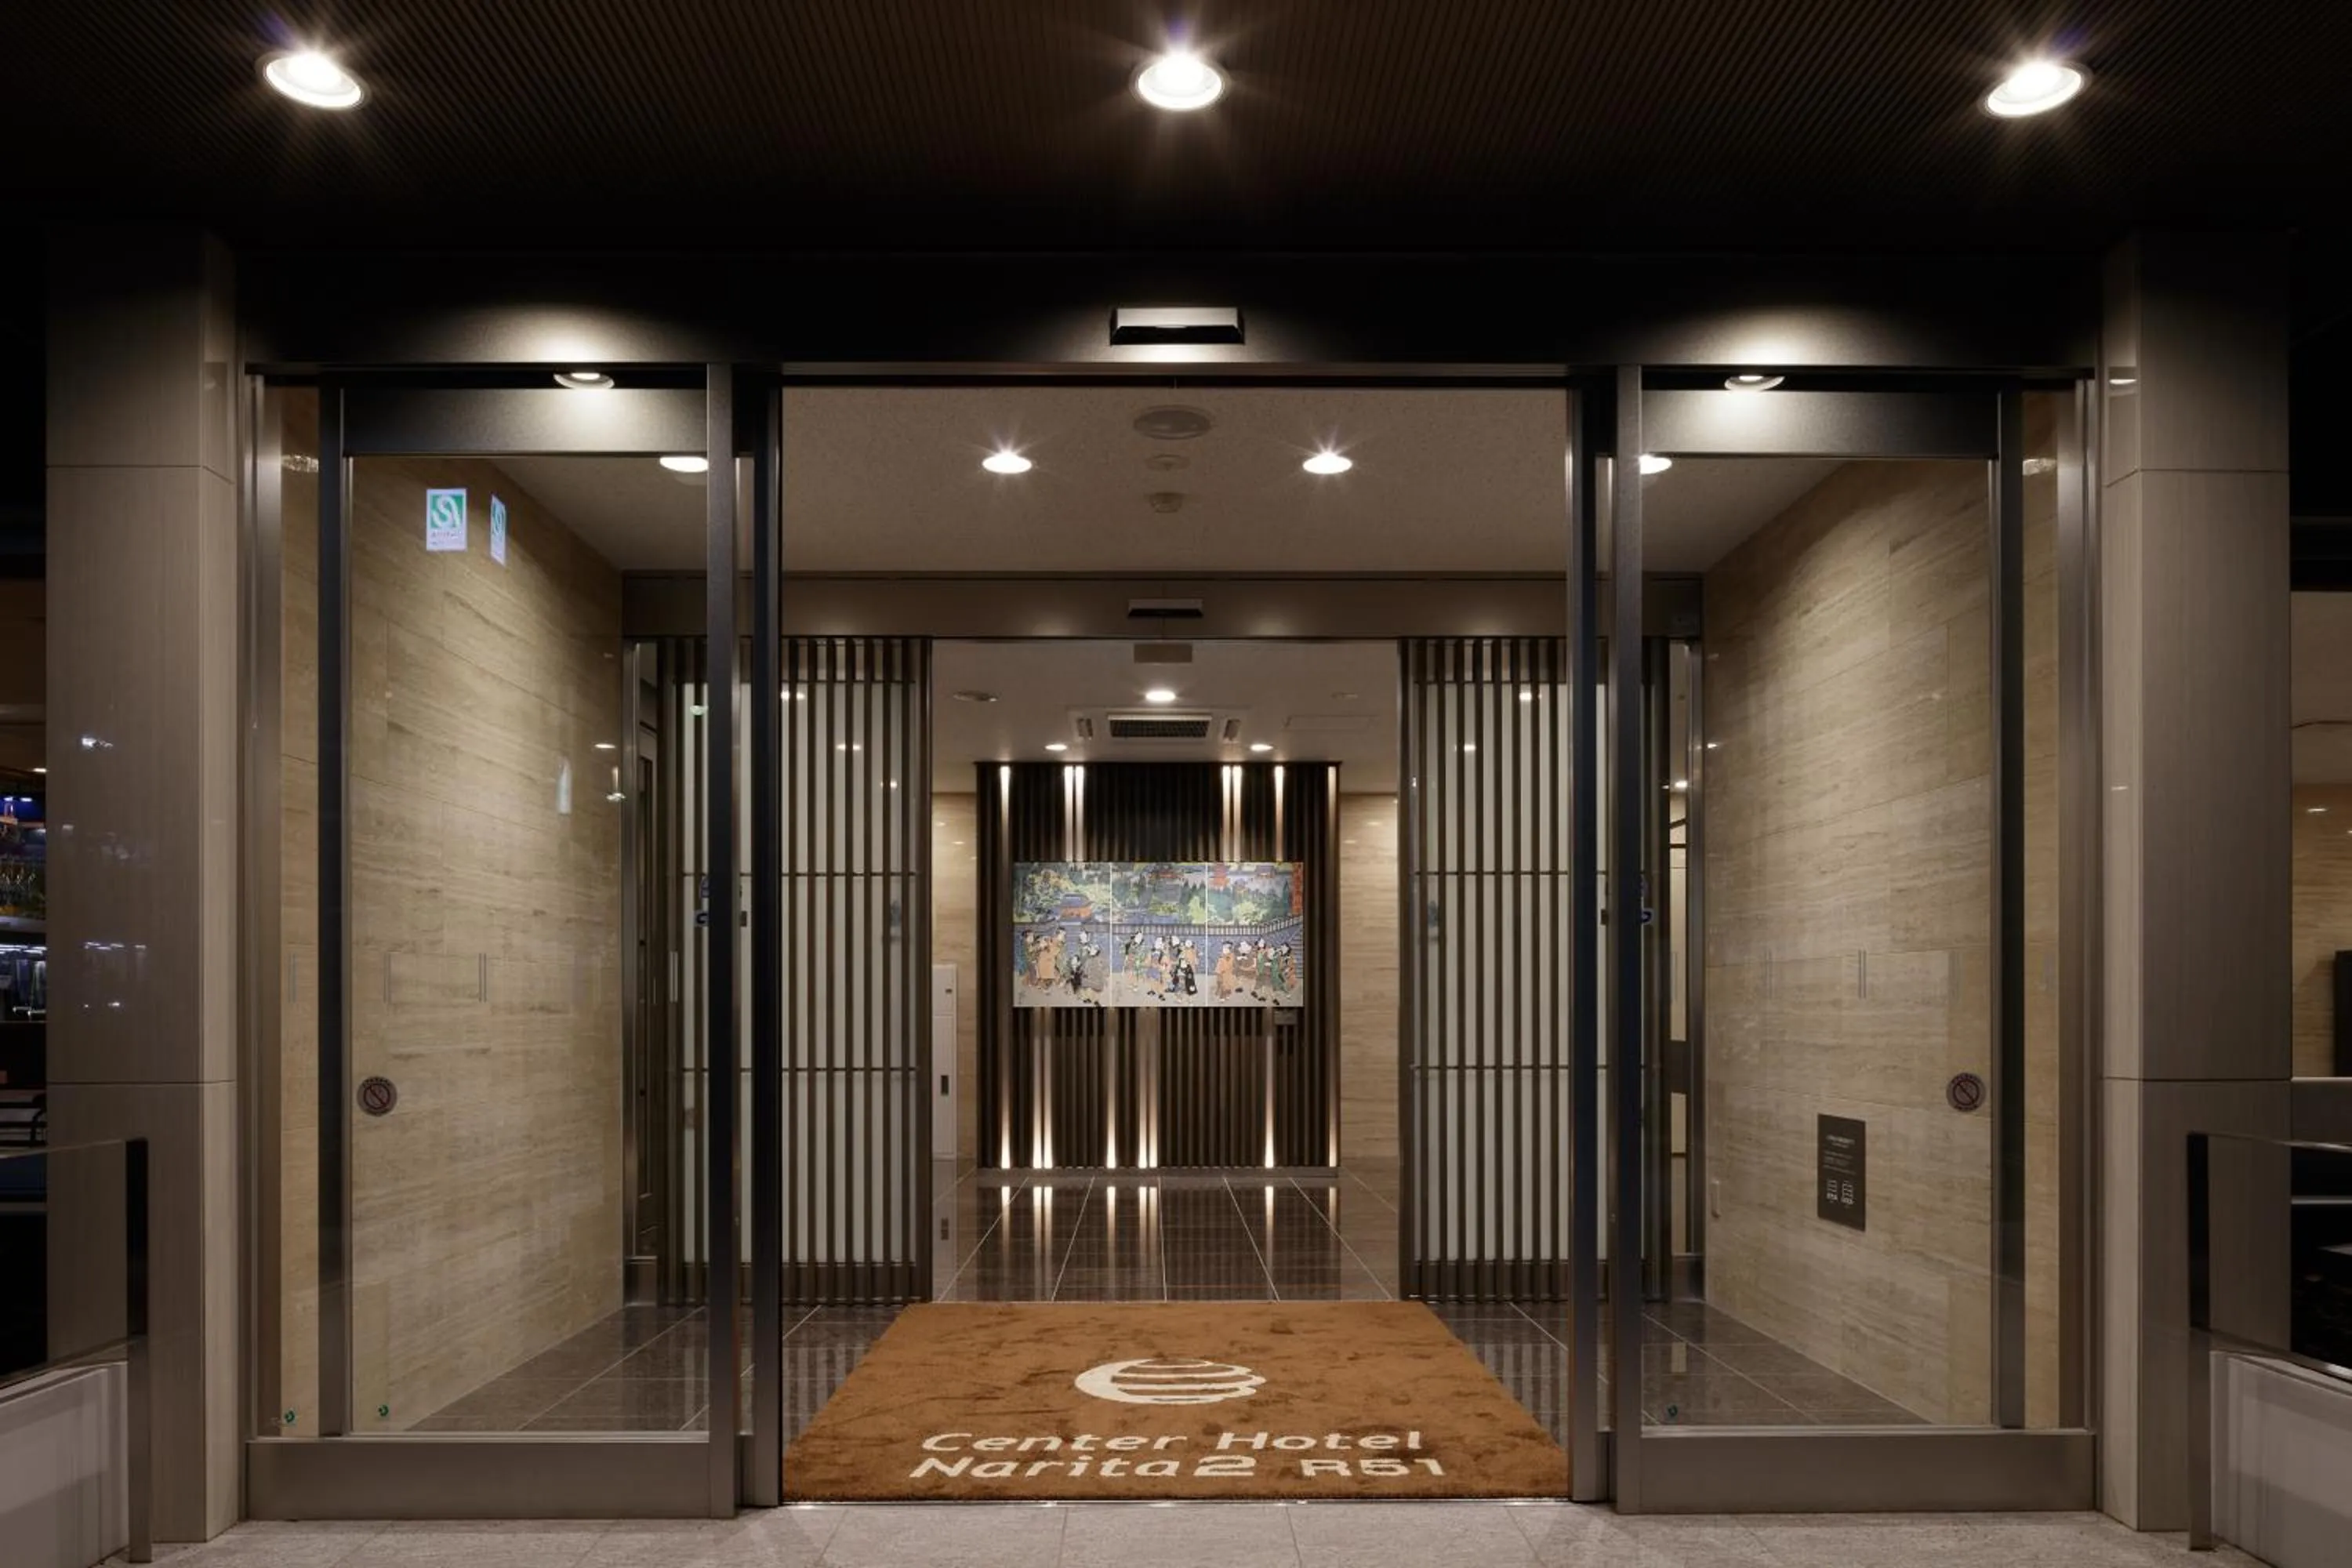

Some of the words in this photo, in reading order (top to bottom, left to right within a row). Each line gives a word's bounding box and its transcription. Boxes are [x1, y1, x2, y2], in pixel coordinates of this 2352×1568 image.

[921, 1432, 1188, 1451] Center
[1215, 1431, 1421, 1450] Hotel
[1300, 1457, 1446, 1476] R51
